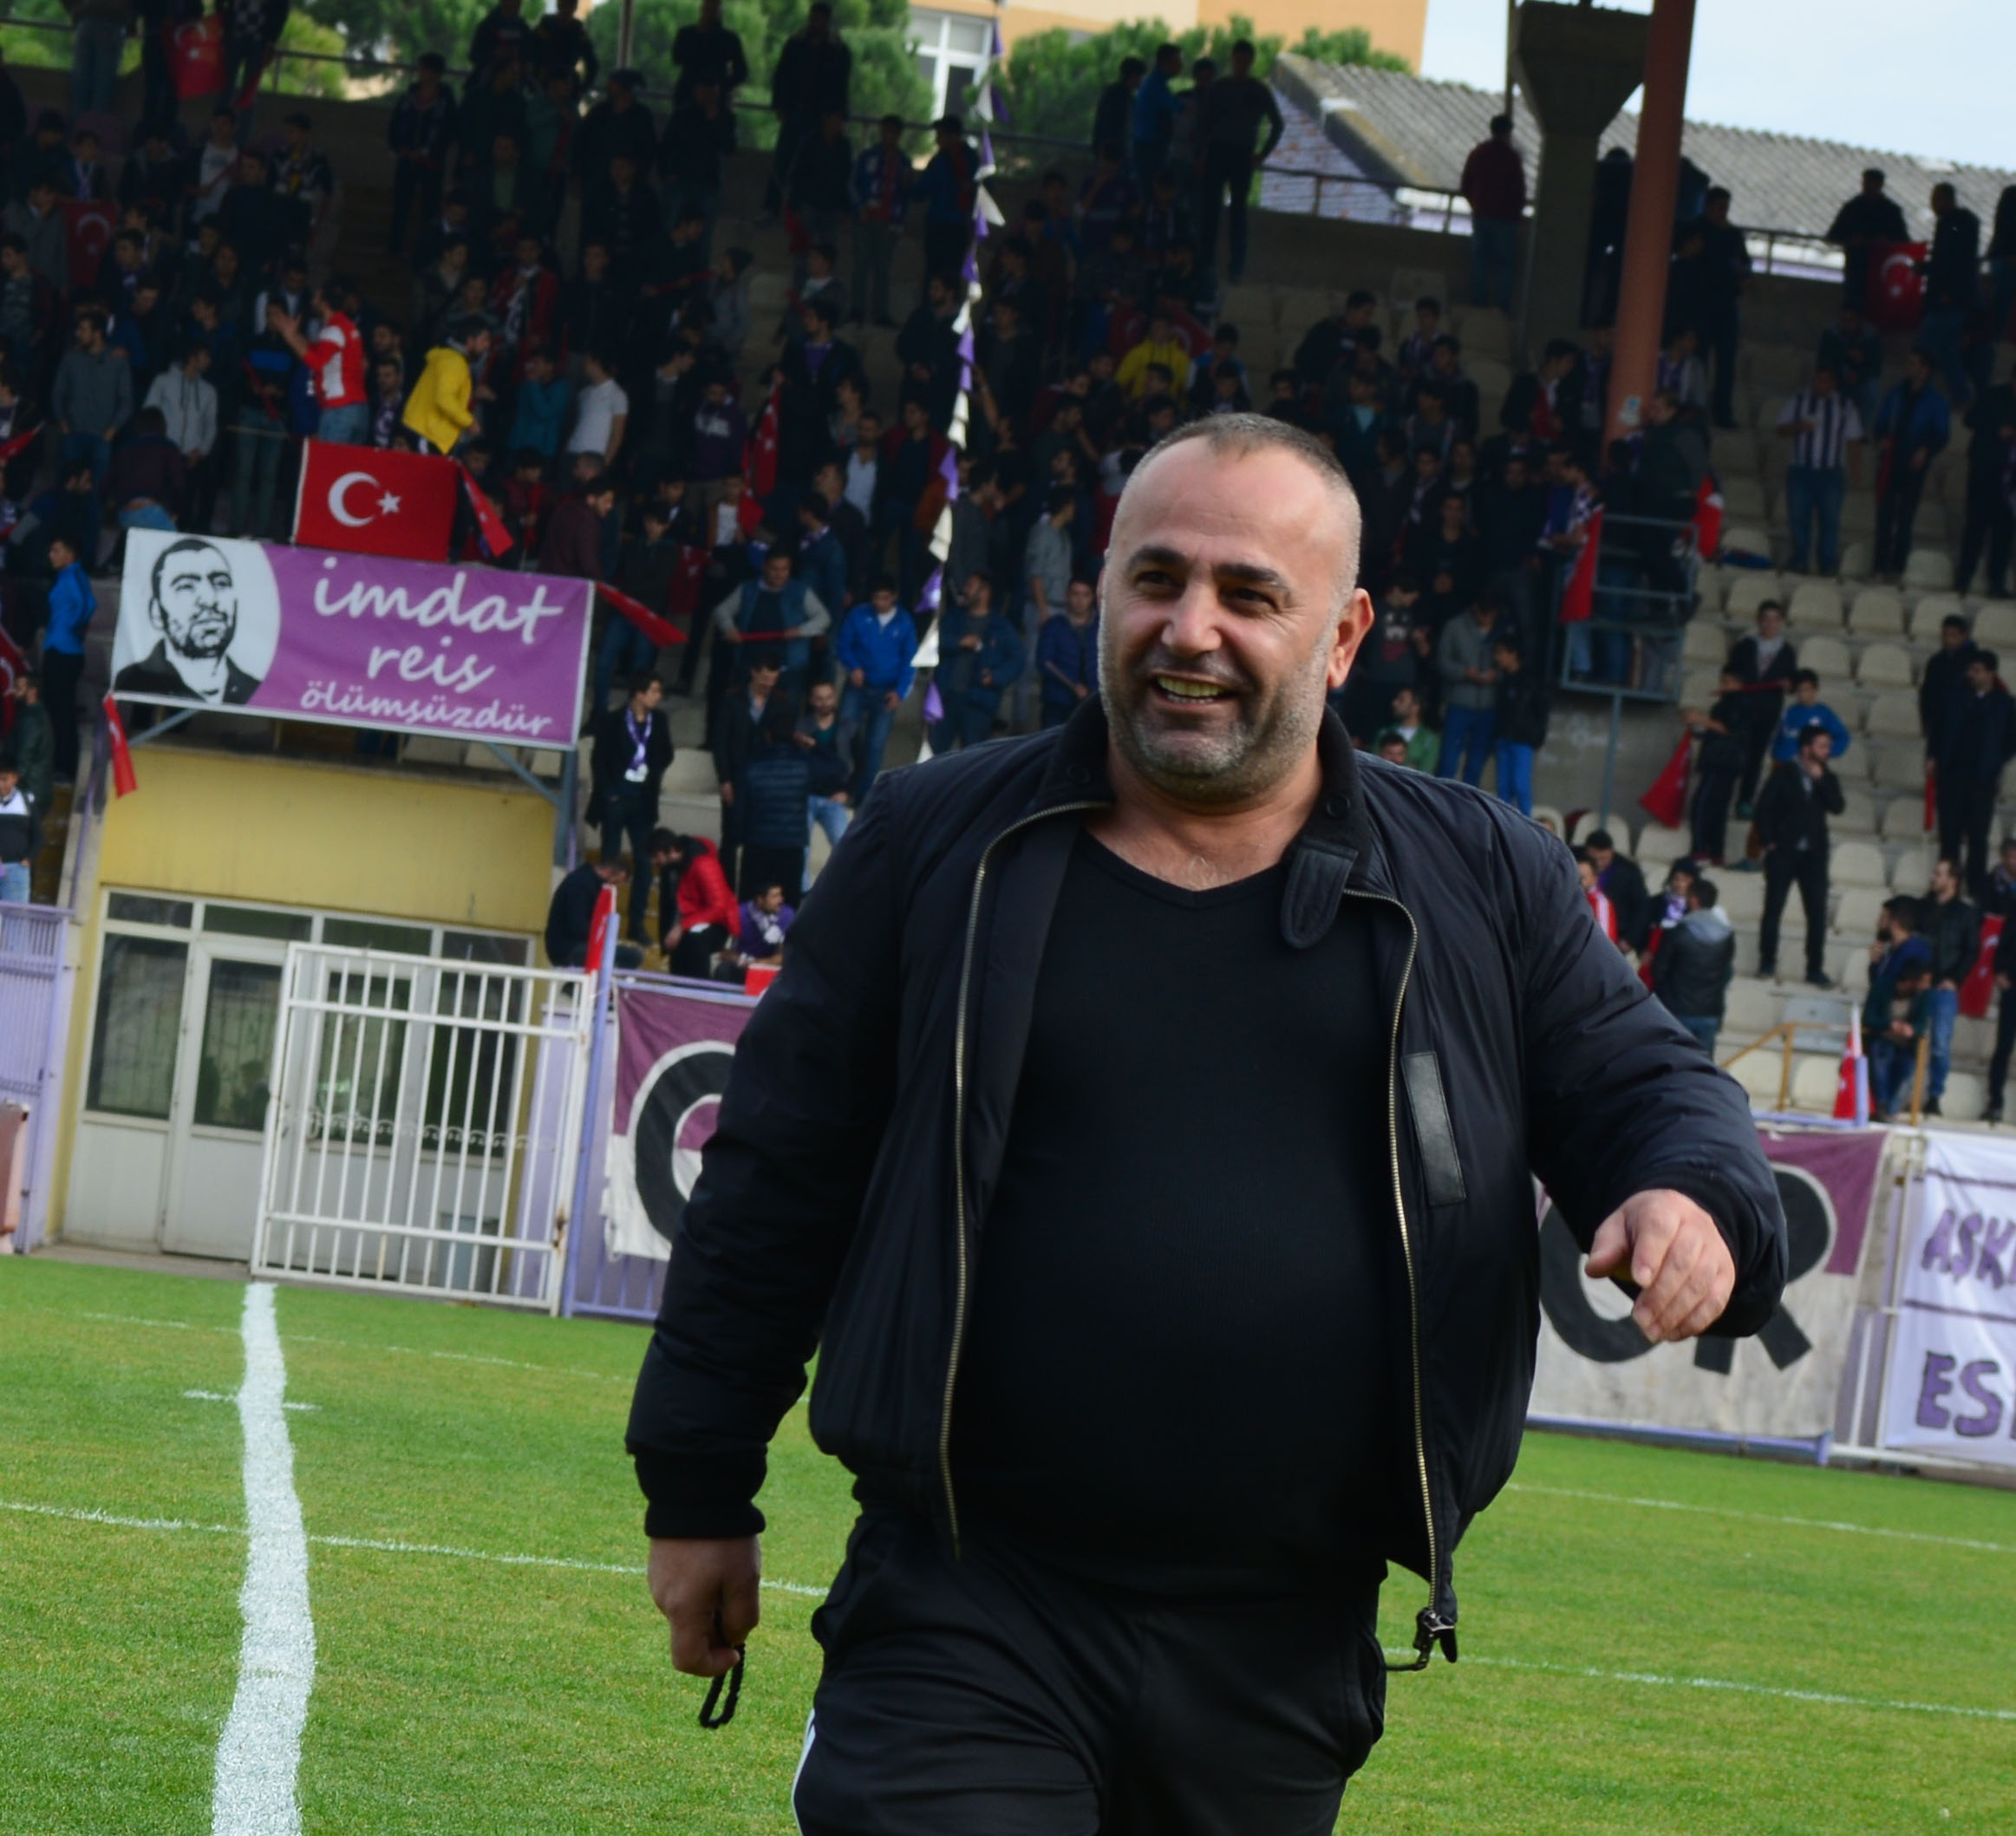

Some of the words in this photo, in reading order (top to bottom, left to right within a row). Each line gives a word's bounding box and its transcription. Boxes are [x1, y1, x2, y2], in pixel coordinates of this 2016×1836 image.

[314, 556, 564, 644] imdat
[367, 637, 496, 693] reis
[300, 681, 552, 735] ölümsüzdür
[1915, 1349, 2016, 1440] ES
